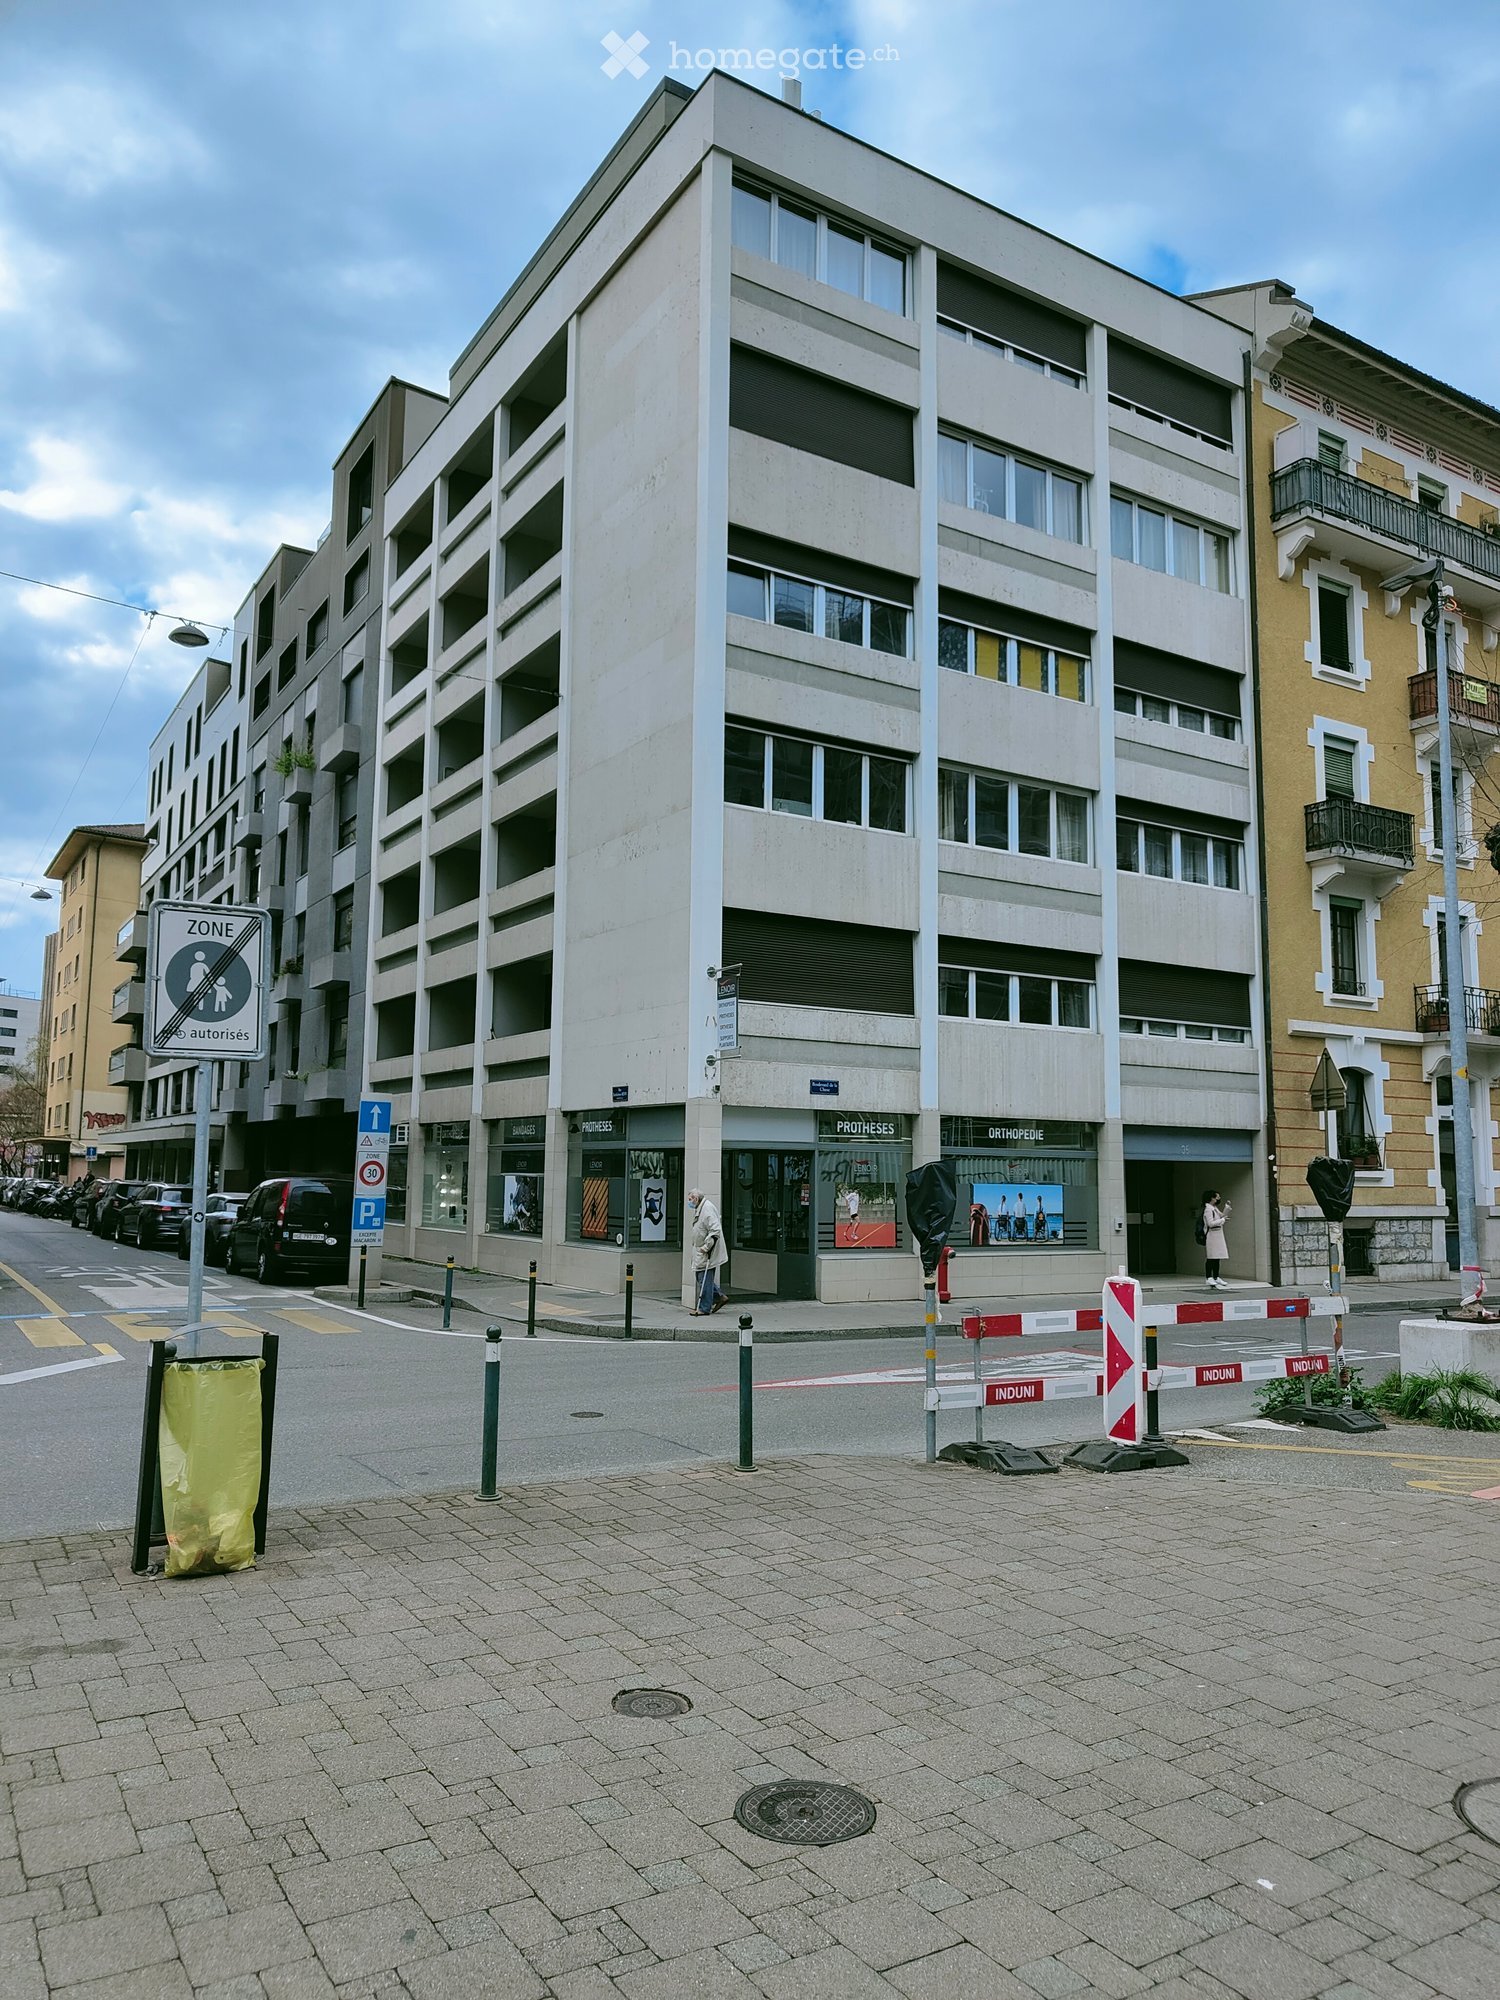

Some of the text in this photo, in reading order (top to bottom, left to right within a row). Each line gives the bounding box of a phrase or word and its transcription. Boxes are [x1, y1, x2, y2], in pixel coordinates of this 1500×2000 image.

[187, 919, 234, 938] ZONE
[718, 984, 736, 994] LENOIR
[190, 1028, 250, 1041] autorisés
[512, 1124, 536, 1136] BANDAGES
[582, 1120, 613, 1133] PROTHESES
[836, 1120, 895, 1136] PROTHESES
[988, 1127, 1044, 1141] ORTHOPEDIE
[366, 1168, 378, 1178] 30
[359, 1201, 376, 1225] P
[1292, 1359, 1324, 1373] INDUNI
[1203, 1368, 1235, 1382] INDUNI
[995, 1385, 1035, 1400] INDUNI
